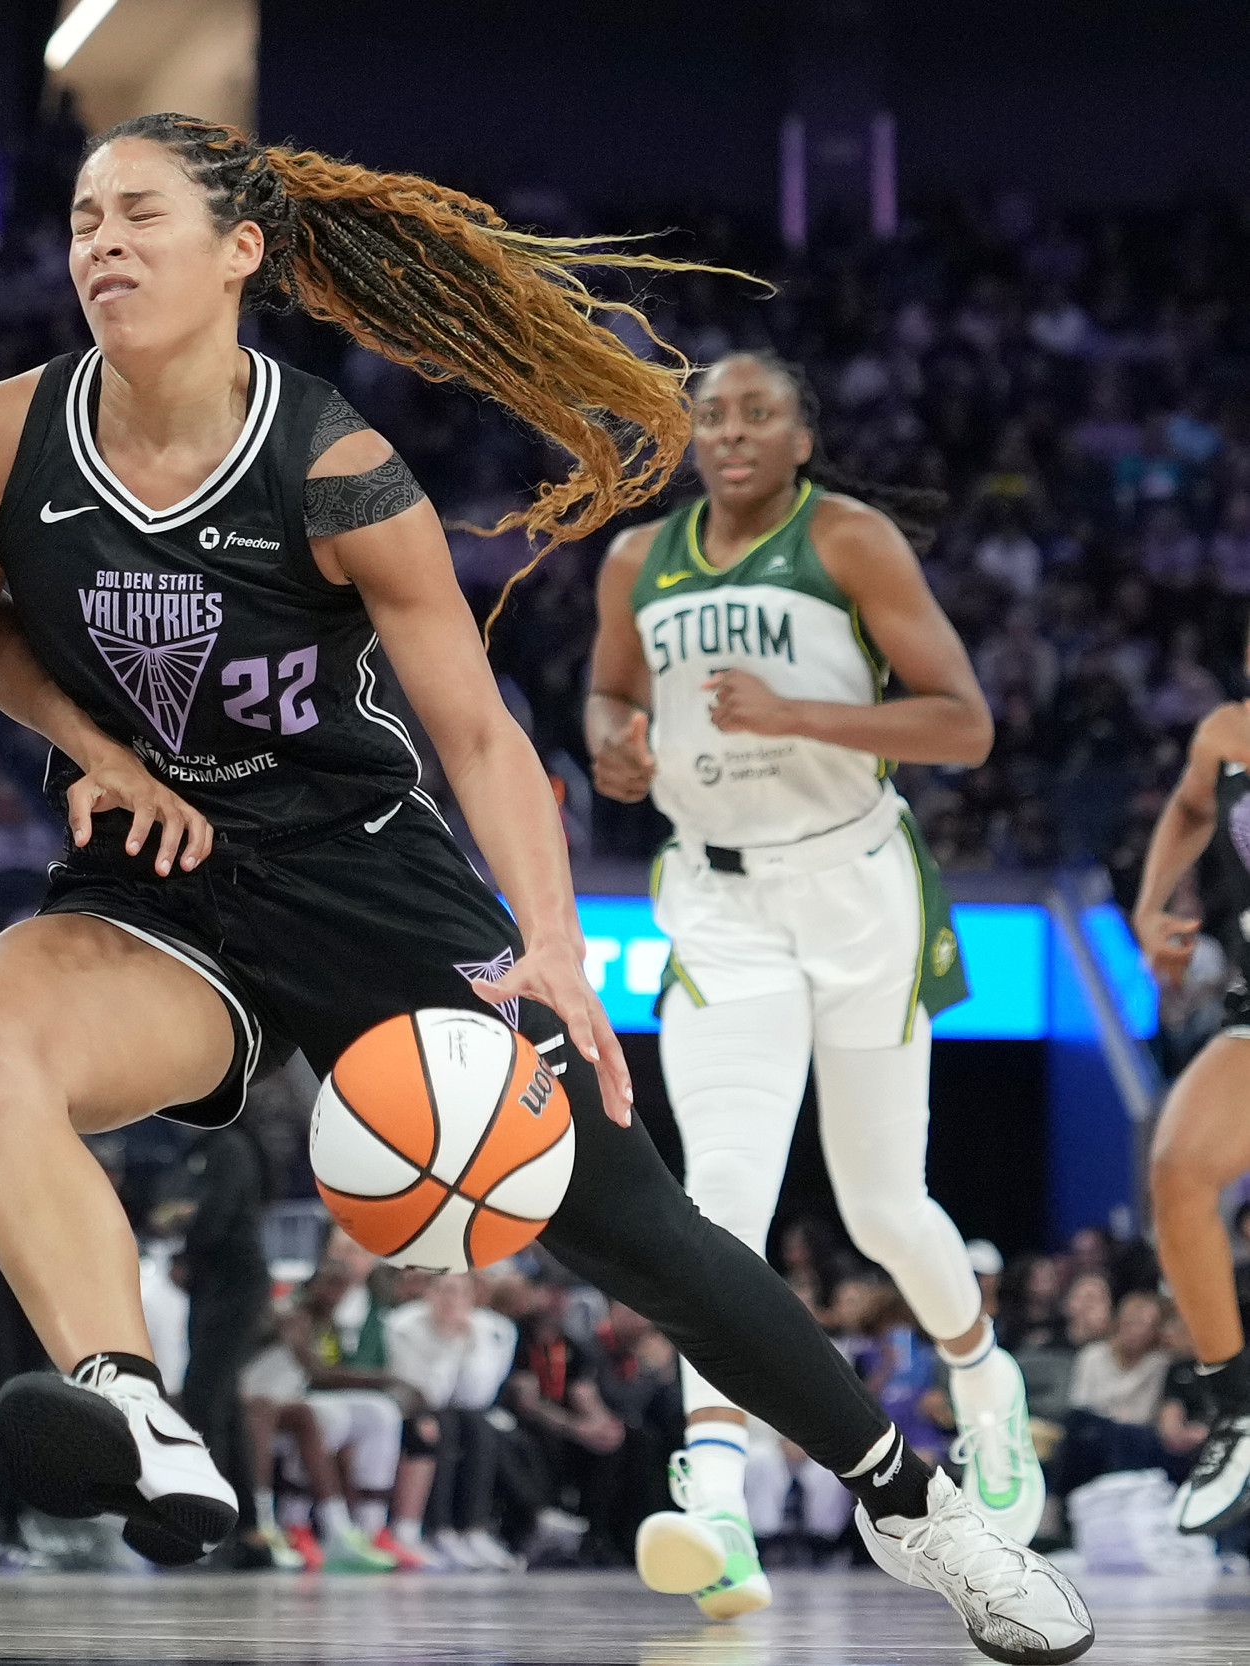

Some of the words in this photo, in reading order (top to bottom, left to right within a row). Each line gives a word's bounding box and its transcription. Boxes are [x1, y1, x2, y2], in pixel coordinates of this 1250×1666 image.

[223, 531, 281, 551] freedom
[96, 570, 153, 590] GOLDEN
[158, 573, 204, 591] STATE
[78, 588, 223, 644] VALKYRIES
[652, 602, 797, 677] STORM
[221, 644, 319, 736] 22
[169, 752, 278, 783] PERMANENTE
